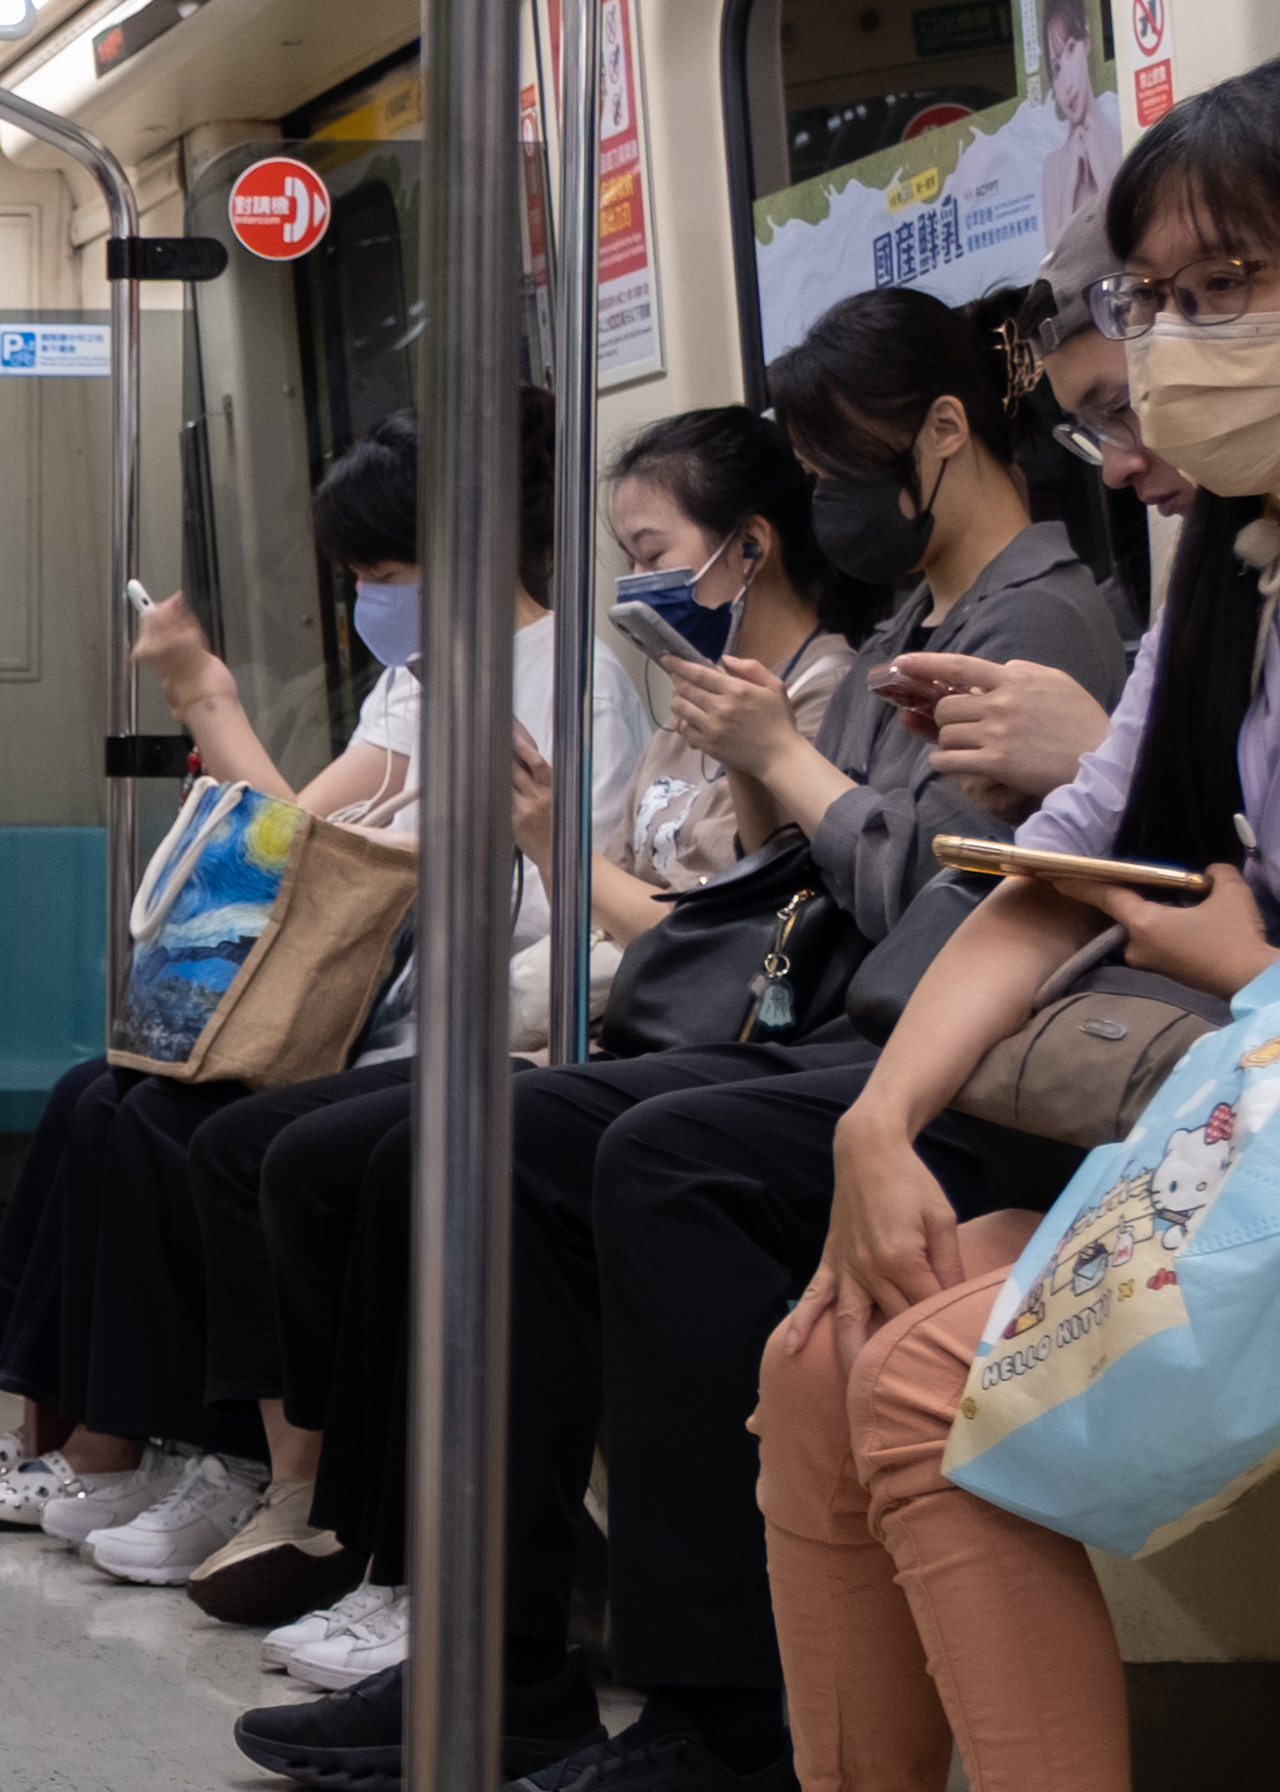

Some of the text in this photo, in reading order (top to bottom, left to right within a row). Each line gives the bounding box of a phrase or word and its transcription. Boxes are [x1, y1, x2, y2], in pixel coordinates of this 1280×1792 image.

[873, 194, 965, 289] 國產鮮乳
[3, 334, 25, 361] P
[981, 1334, 1052, 1390] HELLO
[1054, 1286, 1113, 1350] KITTY
